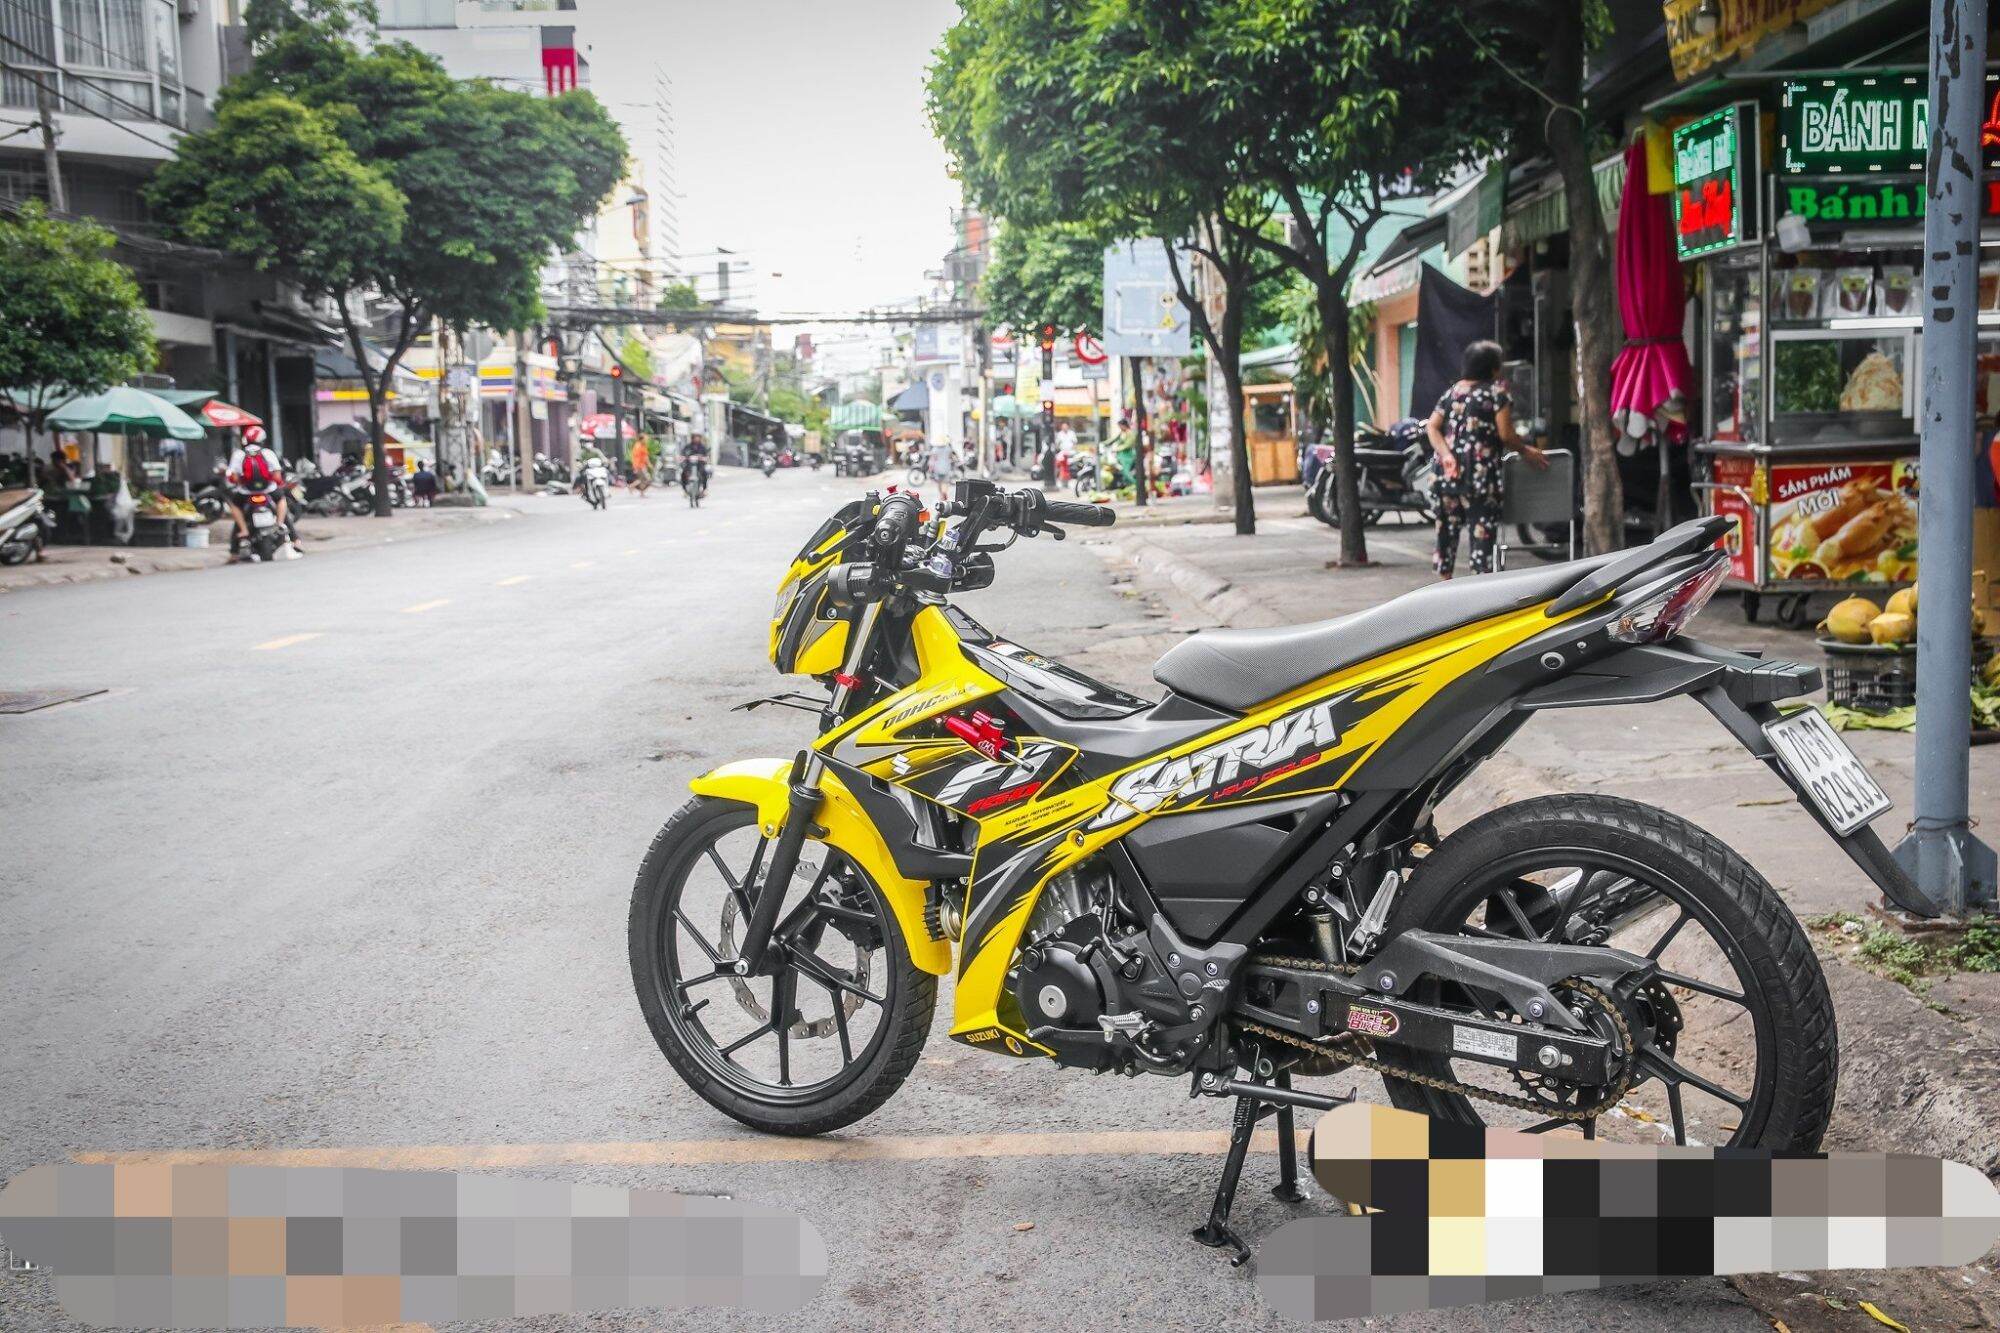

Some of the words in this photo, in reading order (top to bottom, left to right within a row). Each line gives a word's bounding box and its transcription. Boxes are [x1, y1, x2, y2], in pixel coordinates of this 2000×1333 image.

[1802, 87, 1901, 153] BÁNH
[1087, 688, 1362, 831] SATRIA
[966, 1028, 1001, 1043] SUZUKI
